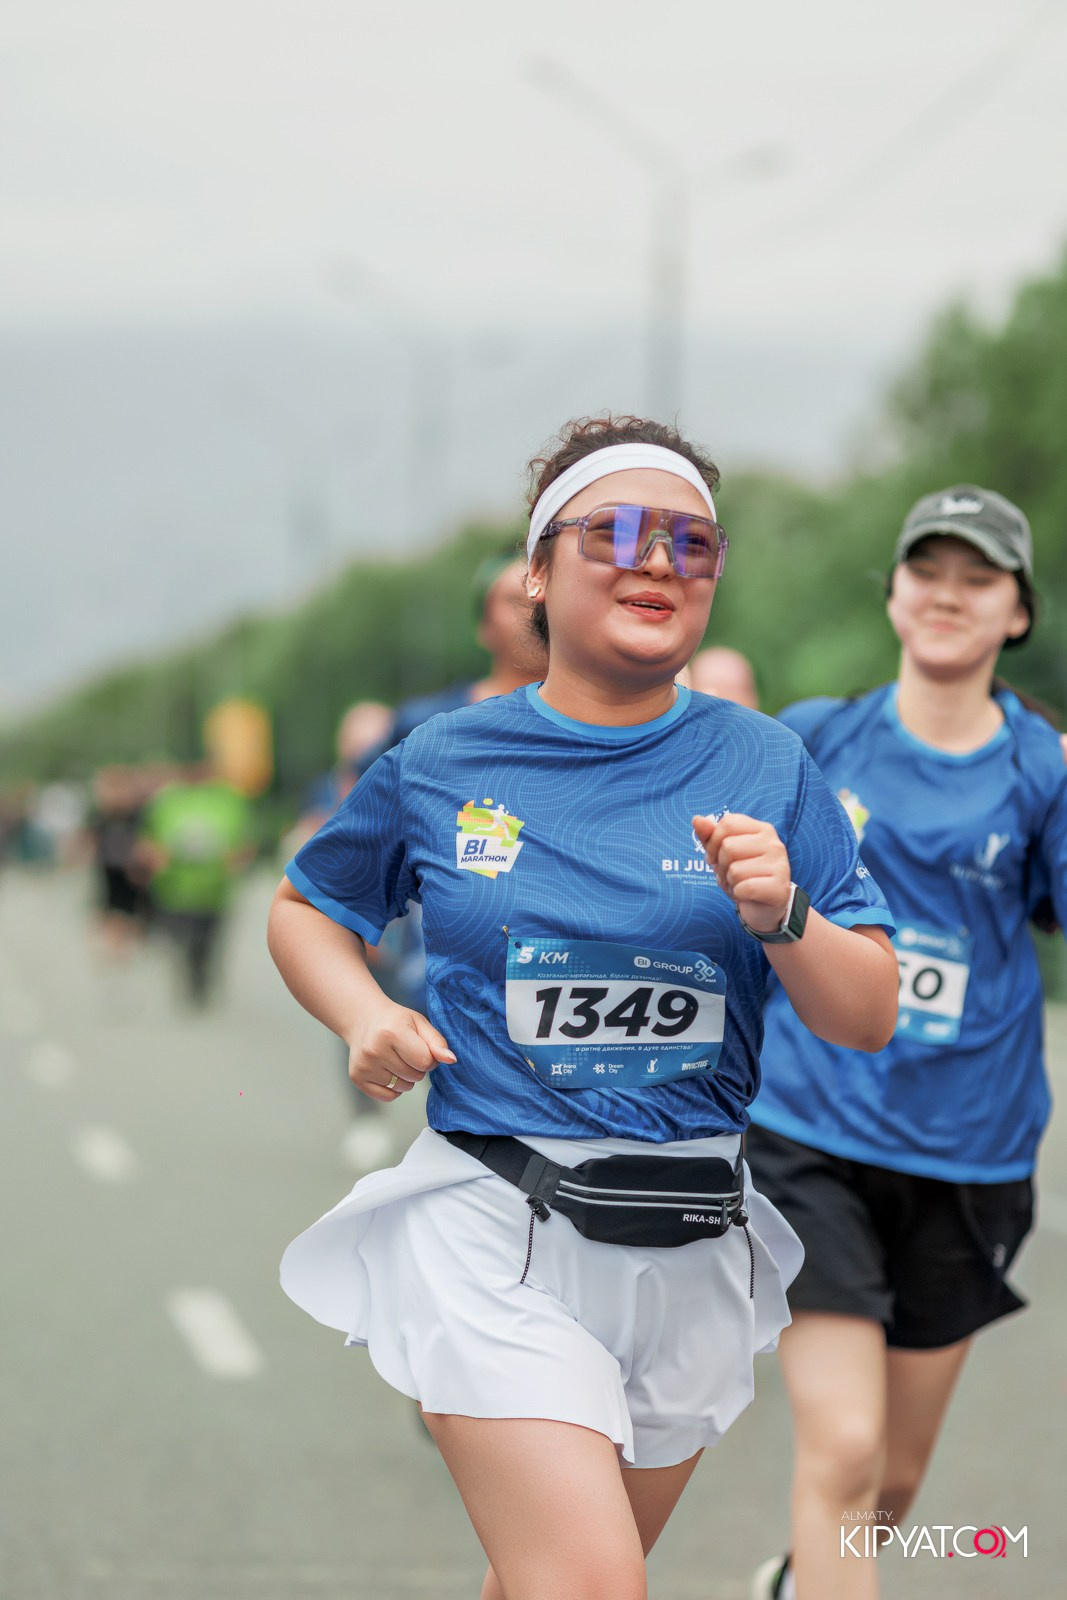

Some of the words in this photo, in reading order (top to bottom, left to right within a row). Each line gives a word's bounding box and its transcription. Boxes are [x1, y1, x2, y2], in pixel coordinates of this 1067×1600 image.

[463, 839, 488, 856] BI
[460, 855, 508, 863] MARATHON
[661, 859, 679, 872] BI
[517, 947, 534, 963] 5
[538, 952, 569, 963] KM
[652, 961, 694, 974] GROUP
[535, 986, 699, 1039] 1349
[681, 1059, 709, 1072] INVICTUS
[683, 1213, 731, 1225] RIKA-SHP
